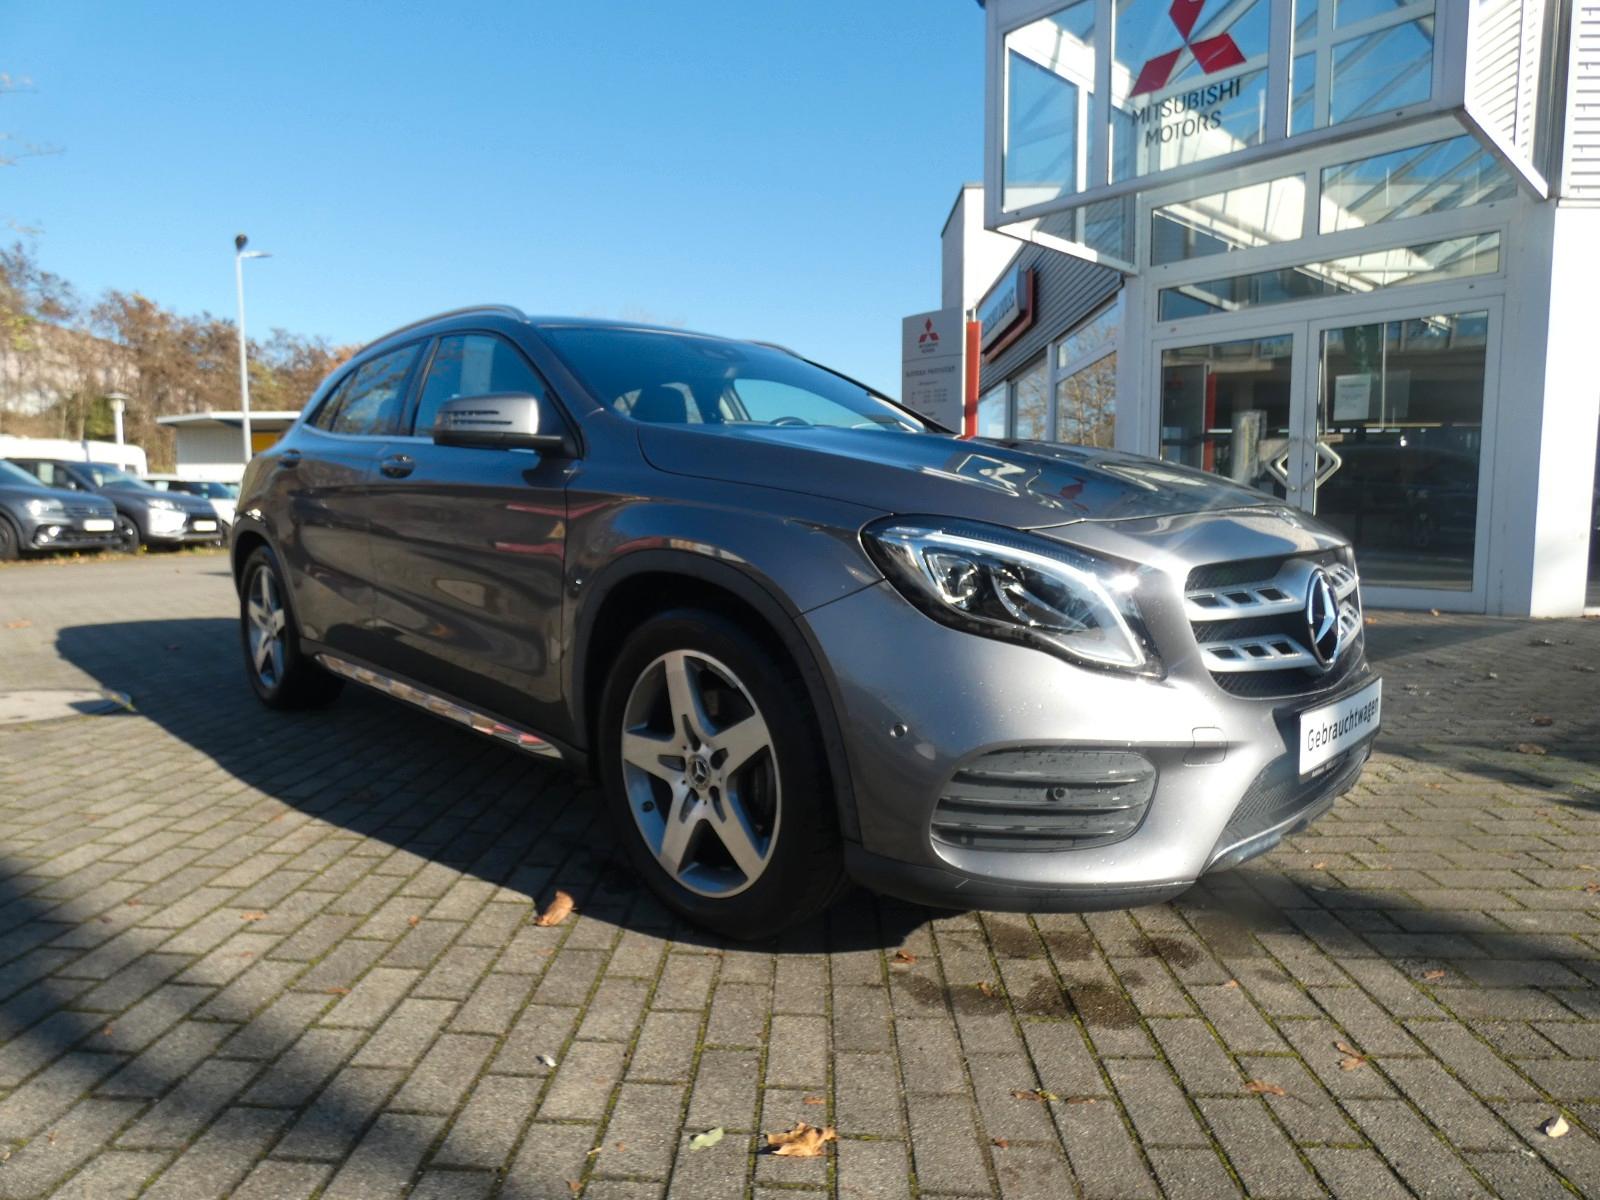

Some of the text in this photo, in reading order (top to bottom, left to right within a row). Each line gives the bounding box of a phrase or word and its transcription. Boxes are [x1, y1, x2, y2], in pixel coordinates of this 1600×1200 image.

[1131, 78, 1241, 127] MITSUBISHI
[1145, 109, 1223, 148] MOTORS
[1307, 697, 1379, 752] Gebrauchtwagen
